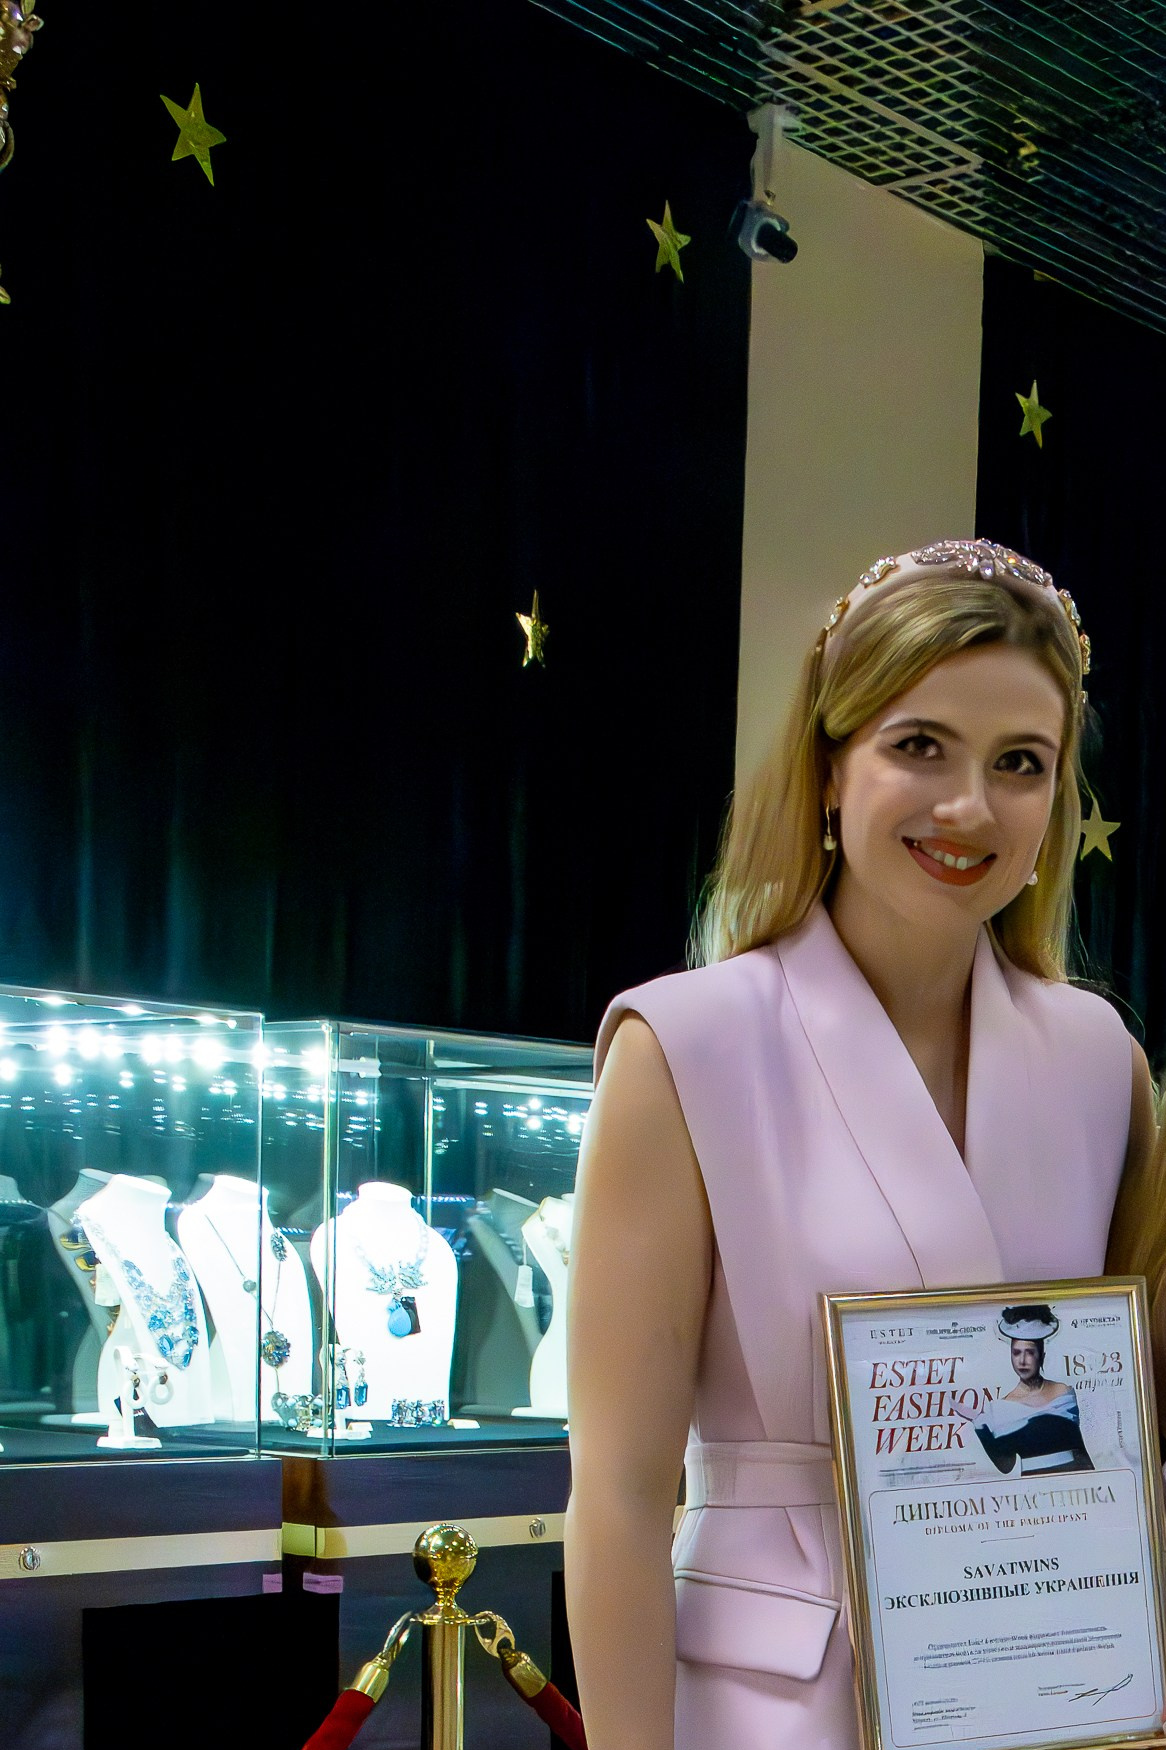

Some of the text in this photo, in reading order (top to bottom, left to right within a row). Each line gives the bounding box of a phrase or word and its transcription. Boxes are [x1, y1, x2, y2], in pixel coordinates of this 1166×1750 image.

[869, 1357, 964, 1389] ESTET
[875, 1421, 968, 1456] WEEK
[893, 1497, 986, 1525] ДИПЛОМ
[925, 1522, 974, 1535] DIPLOMA
[963, 1557, 1060, 1580] SAVATWINS
[884, 1571, 1140, 1610] ЭКСКЛЮЗИВНЫЕ УКРАШЕНИЯ
